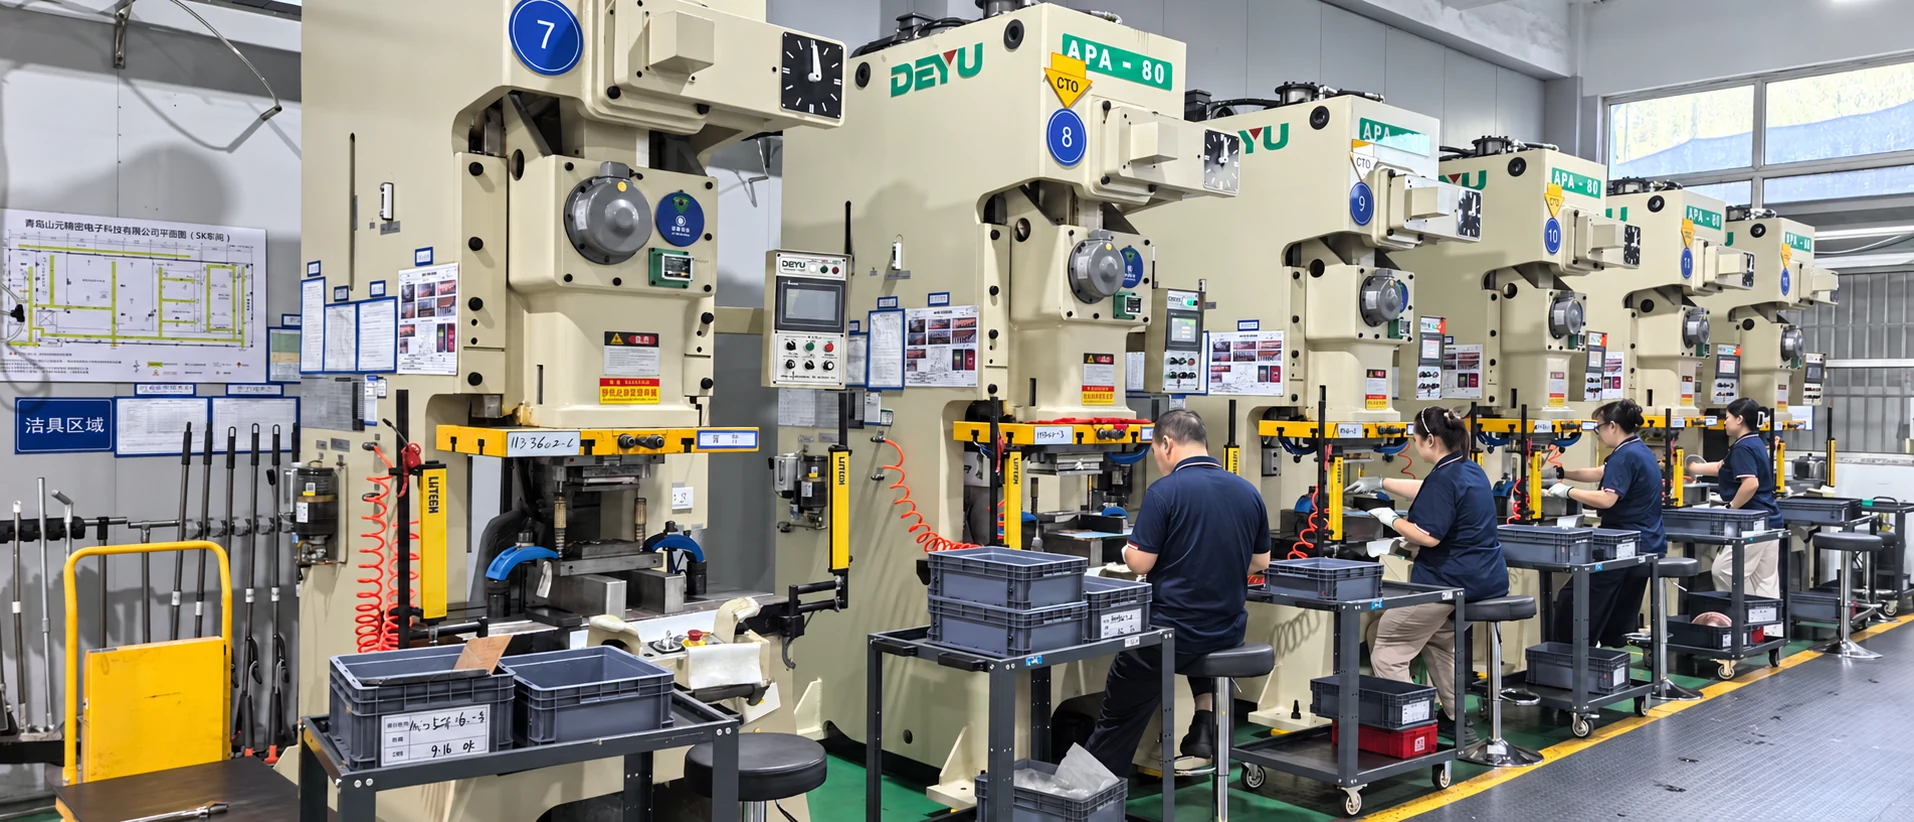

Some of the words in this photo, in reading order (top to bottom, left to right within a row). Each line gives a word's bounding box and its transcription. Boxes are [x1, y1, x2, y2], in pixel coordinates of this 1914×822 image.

[536, 19, 556, 49] 7
[890, 42, 984, 98] DEYU
[1066, 39, 1113, 71] APA
[1142, 59, 1165, 84] 80
[1056, 76, 1079, 94] CTO
[1061, 126, 1073, 148] 8
[1238, 122, 1290, 155] YU
[1363, 121, 1392, 147] APA
[1356, 157, 1371, 169] CTO
[1554, 170, 1575, 189] APA
[1586, 179, 1599, 195] 80
[1358, 195, 1366, 212] 9
[1548, 228, 1558, 244] 10
[781, 260, 806, 269] DEYU
[25, 416, 105, 434] 洁具区域
